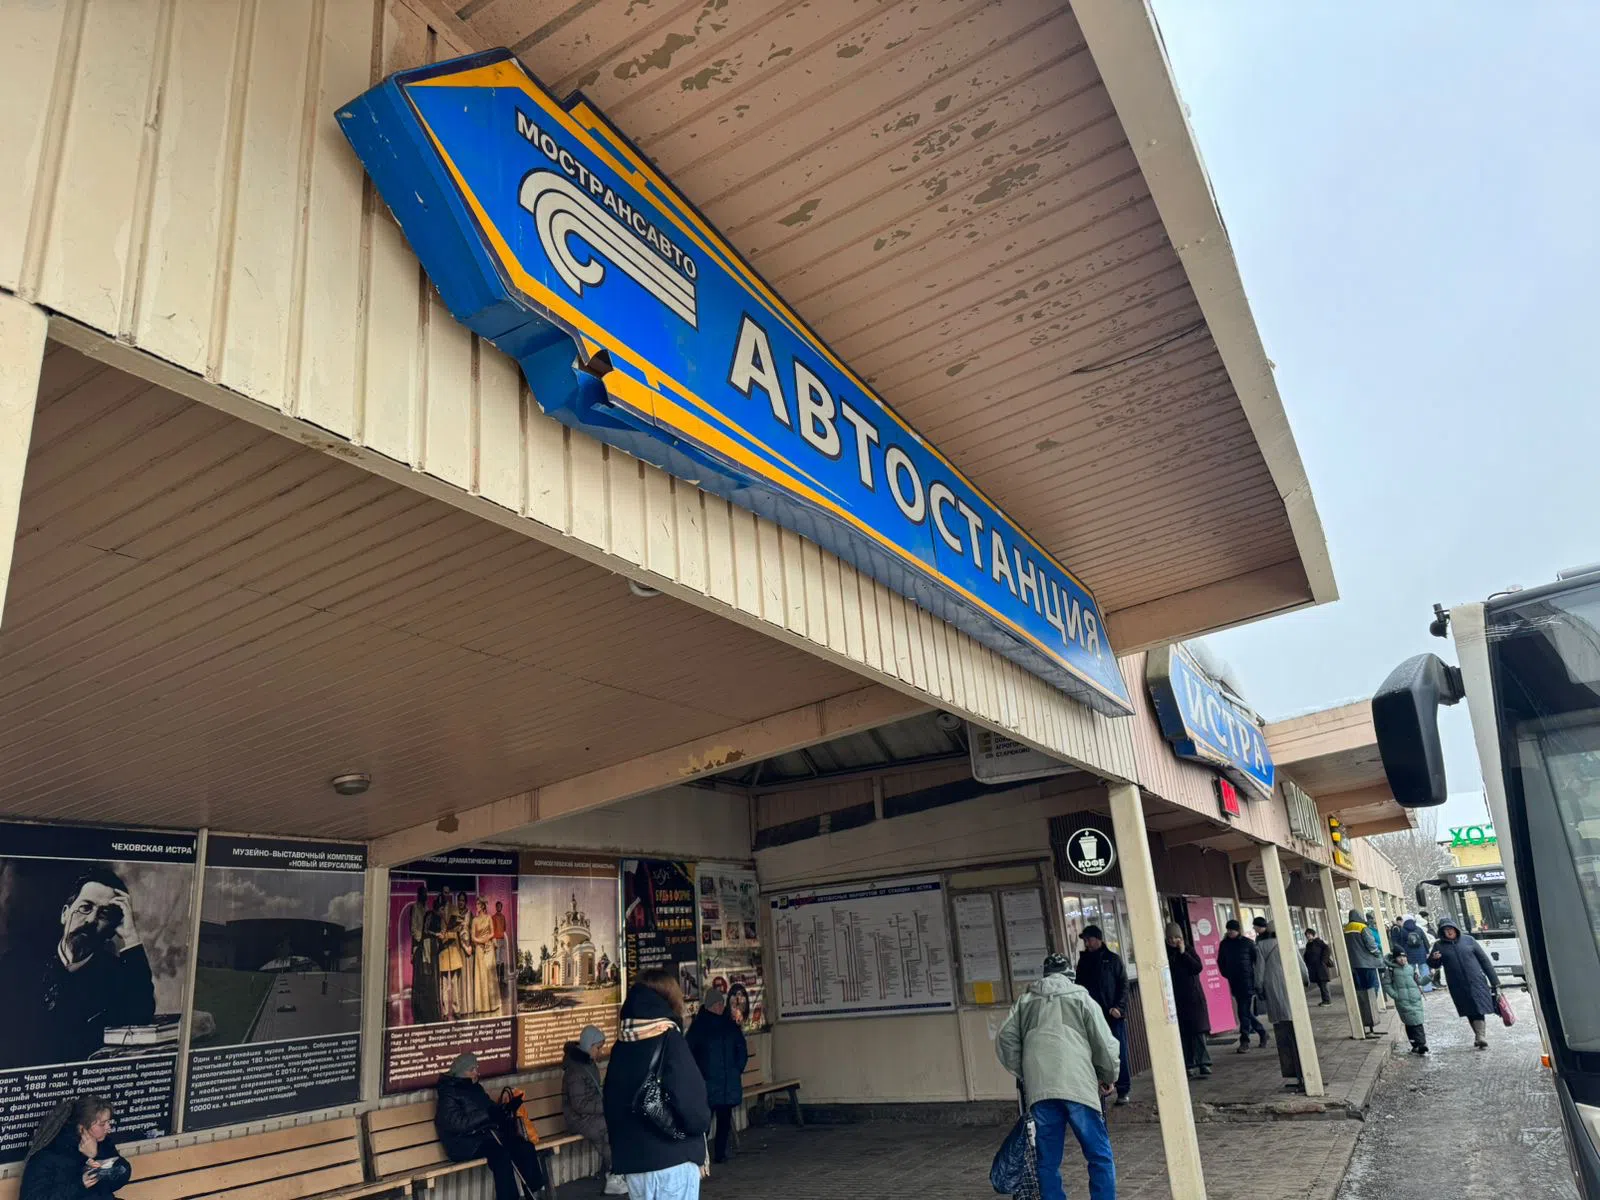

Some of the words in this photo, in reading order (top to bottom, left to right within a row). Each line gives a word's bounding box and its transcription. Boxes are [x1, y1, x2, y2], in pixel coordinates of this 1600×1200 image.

[516, 111, 697, 279] МОСТРАНСАВТО
[729, 315, 1100, 655] АВТОСТАНЦИЯ
[1182, 668, 1267, 776] ИСТРА
[111, 842, 163, 853] ЧЕХОВСКАЯ
[165, 845, 192, 855] ИСТРА
[232, 847, 325, 860] МУЗЕЙНО-ВЫСТАВОЧНЫЙ
[326, 852, 363, 862] КОМПЛЕКС
[447, 856, 497, 865] ДРАМАТИЧЕСКИЙ
[497, 858, 513, 866] ТЕАТР
[1078, 858, 1106, 868] КОФЕ
[82, 1065, 132, 1076] Воскресенске
[25, 1082, 46, 1091] 1888
[49, 1081, 69, 1089] годы.
[72, 1076, 105, 1086] Будущий
[107, 1073, 139, 1081] писатель
[140, 1069, 172, 1078] проходил
[10, 1100, 56, 1112] факультета
[124, 1089, 144, 1098] брата
[149, 1086, 170, 1094] Ивана
[33, 1088, 74, 1099] Чикинской
[76, 1084, 111, 1093] больнице
[129, 1104, 160, 1113] Бабкино
[190, 1103, 212, 1113] 10000
[120, 1112, 161, 1122] написанных
[1, 1140, 28, 1151] вошли
[117, 1121, 159, 1132] литературы.
